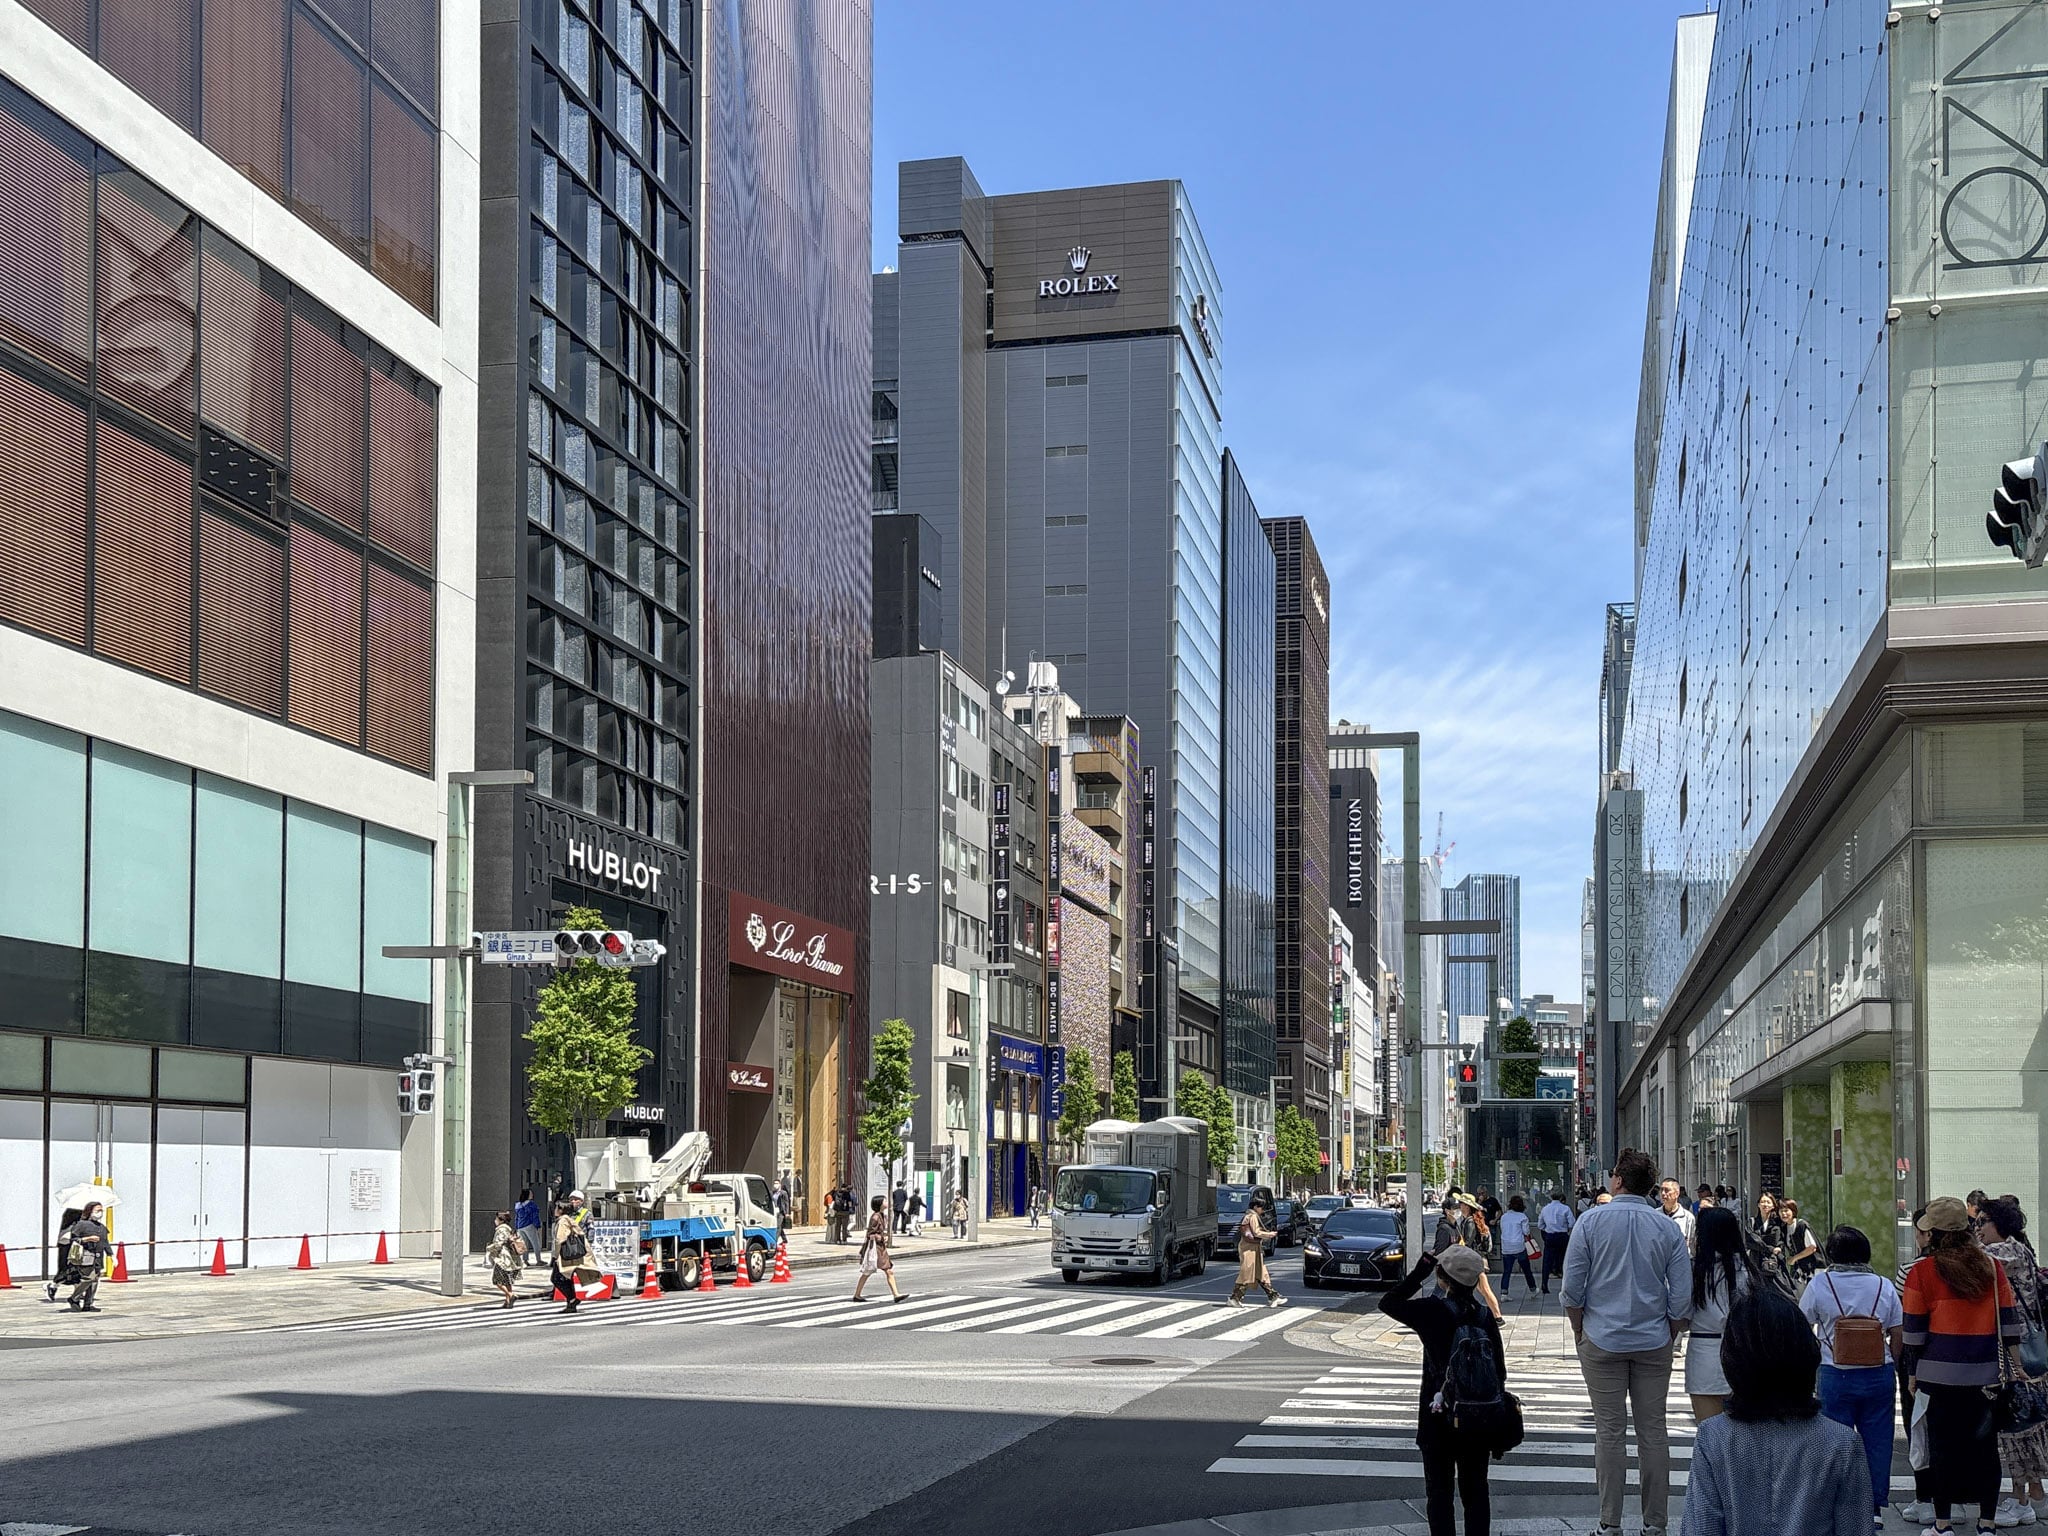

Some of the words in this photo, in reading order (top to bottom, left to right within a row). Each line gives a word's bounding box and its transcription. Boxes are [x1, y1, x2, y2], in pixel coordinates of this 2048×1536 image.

[1040, 274, 1119, 296] ROLEX
[569, 838, 662, 893] HUBLOT
[1348, 798, 1362, 902] BOUCHERON
[487, 940, 553, 953] 銀座三丁目
[506, 953, 526, 961] Ginza
[527, 953, 533, 961] 3
[765, 920, 805, 963] Loro
[804, 933, 844, 976] Piana
[1051, 1050, 1060, 1117] CHAUMET
[624, 1105, 665, 1121] HUBLOT
